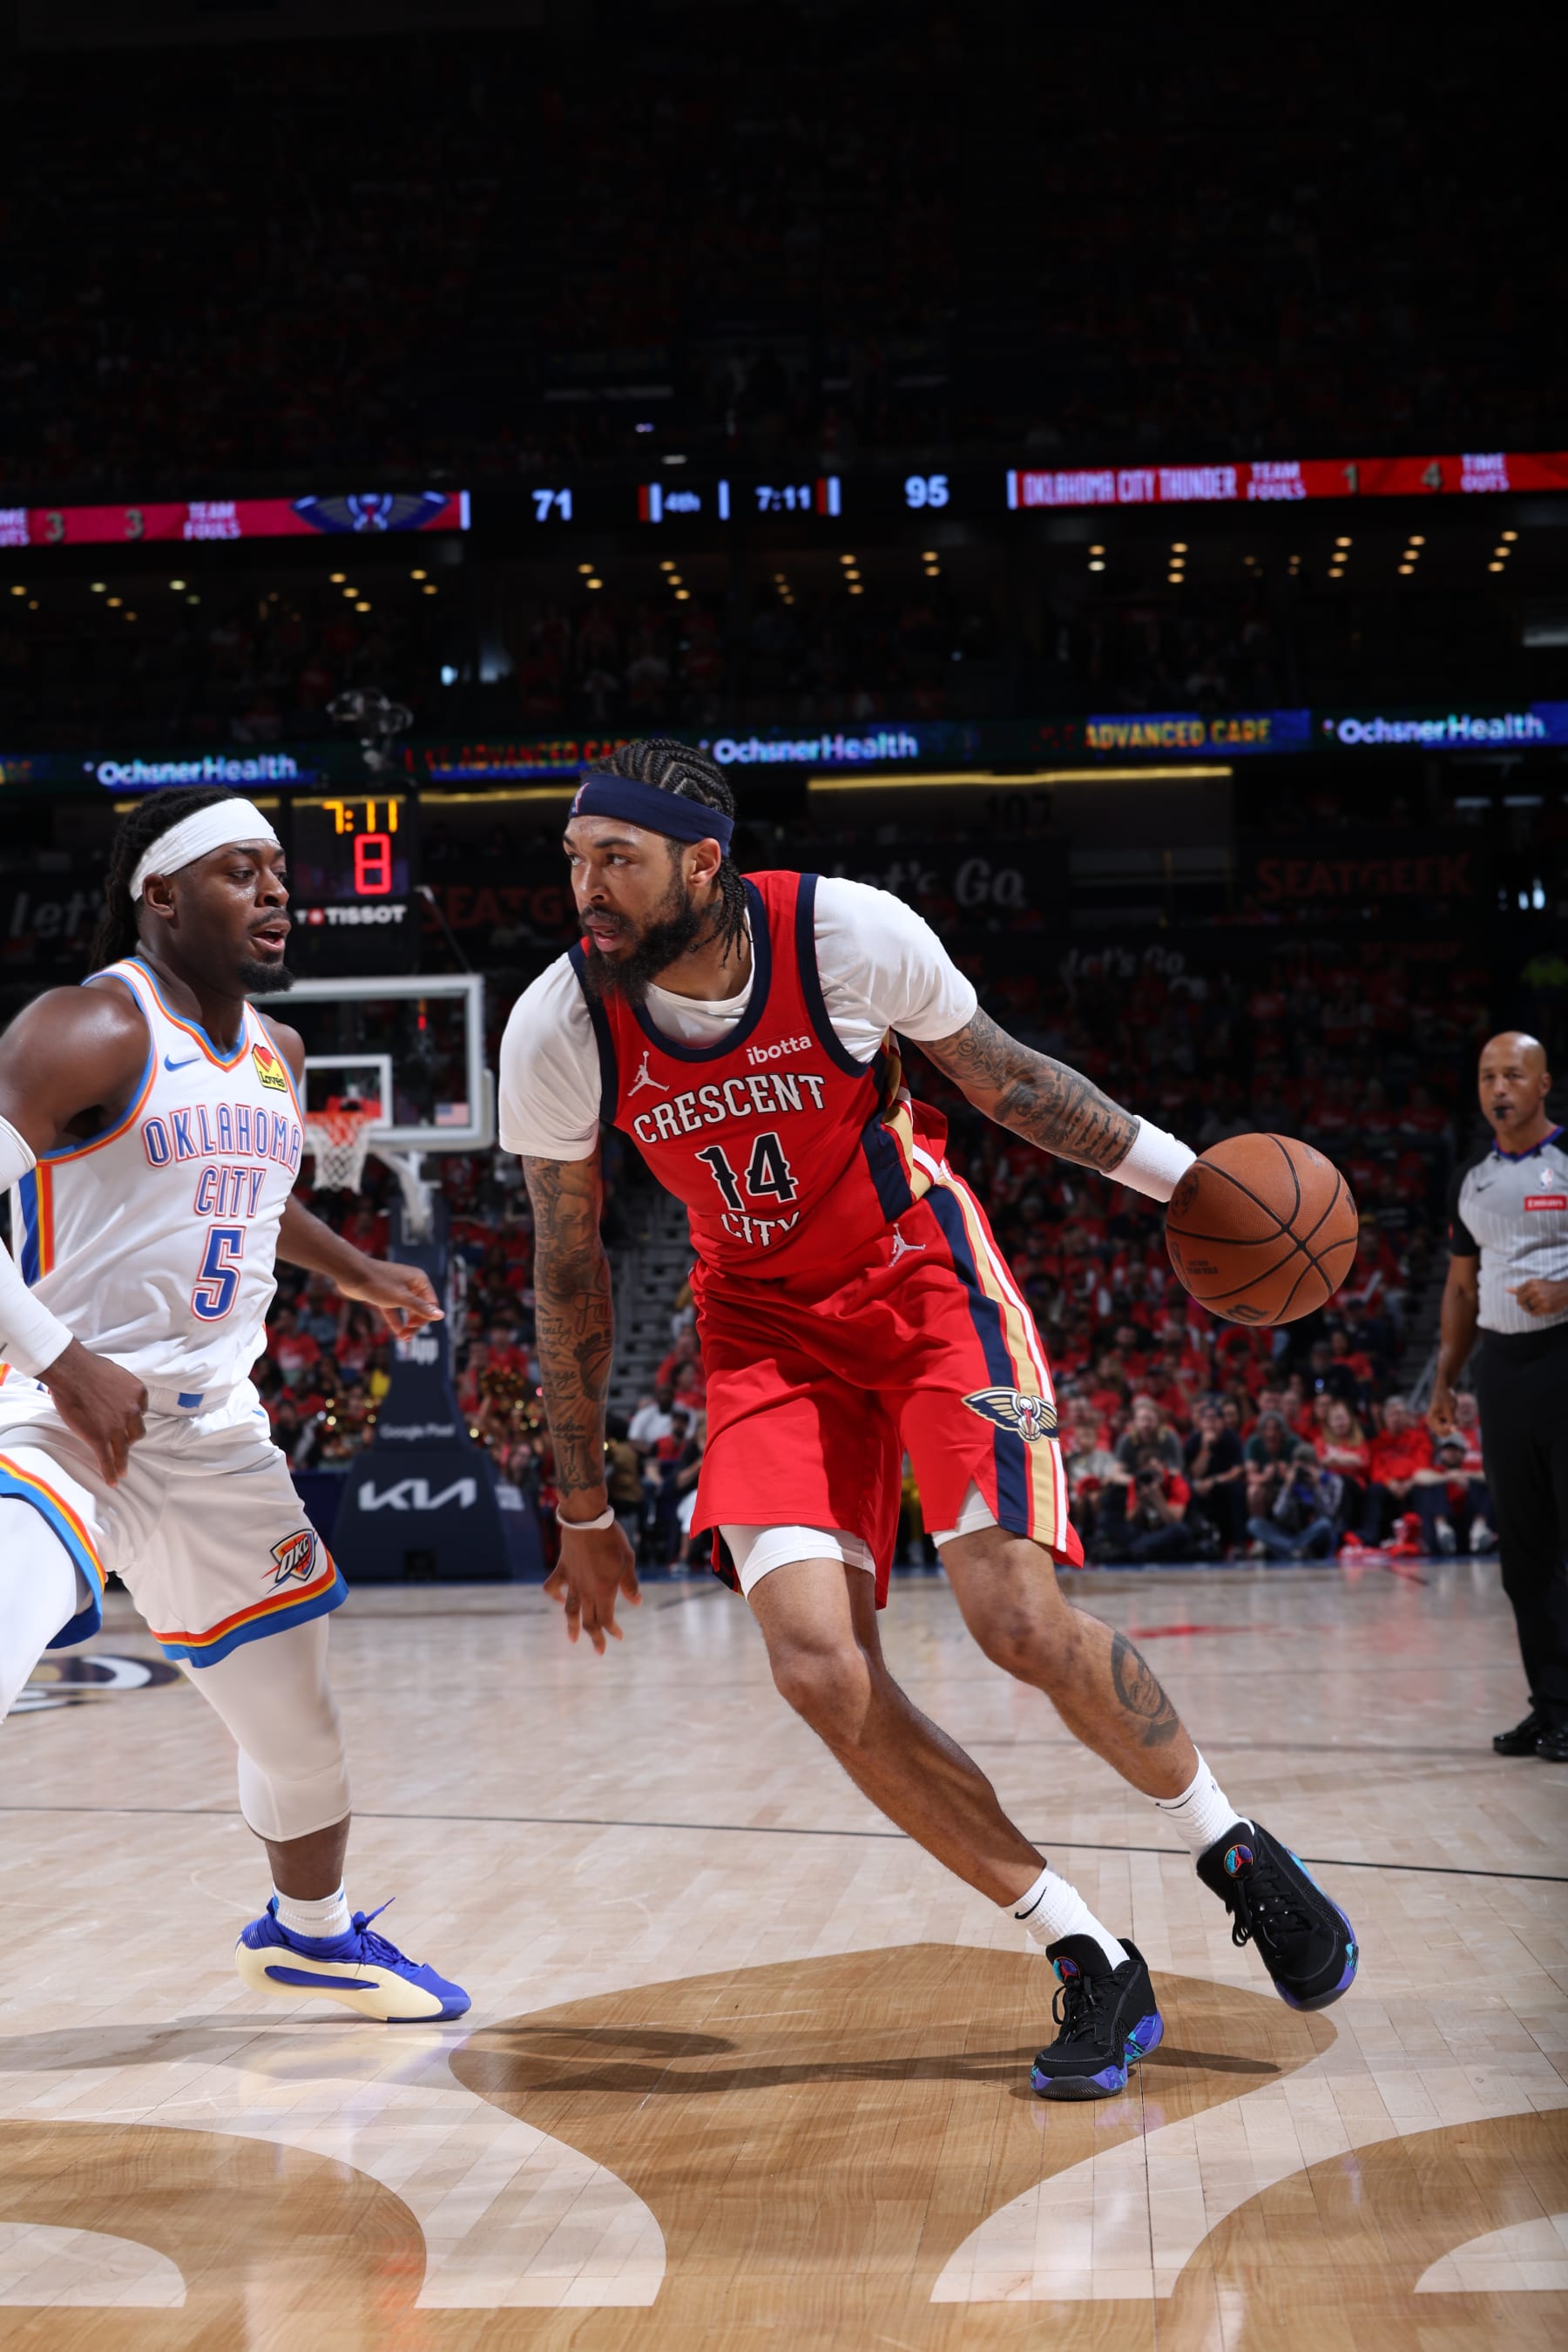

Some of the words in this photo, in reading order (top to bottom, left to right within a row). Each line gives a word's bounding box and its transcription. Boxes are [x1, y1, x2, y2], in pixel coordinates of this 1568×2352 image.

[1251, 461, 1301, 479] TEAM
[1422, 461, 1442, 489] 4
[1462, 453, 1506, 471] TIME
[905, 476, 950, 508] 95
[1023, 470, 1115, 506] OKLAHOMA
[1118, 470, 1157, 503] CITY
[1159, 466, 1237, 502] THUNDER
[1247, 480, 1306, 500] FOULS
[1344, 464, 1358, 492] 1
[1461, 473, 1510, 492] OUTS
[188, 502, 235, 519] TEAM
[532, 489, 572, 522] 71
[755, 485, 810, 510] 7:11
[46, 512, 64, 542] 3
[125, 509, 143, 539] 3
[184, 520, 240, 541] FOULS
[1085, 719, 1205, 749] ADVANCED
[1210, 718, 1273, 744] CARE
[322, 799, 398, 835] 7:11
[354, 833, 391, 895] 8
[325, 904, 406, 925] TISSOT
[420, 882, 574, 934] SEATG
[746, 1035, 813, 1066] ibotta
[632, 1072, 825, 1144] CRESCENT
[141, 1103, 304, 1176] OKLAHOMA
[694, 1132, 799, 1213] 14
[193, 1165, 267, 1218] CITY
[191, 1224, 247, 1321] 5
[357, 1477, 477, 1511] KIA
